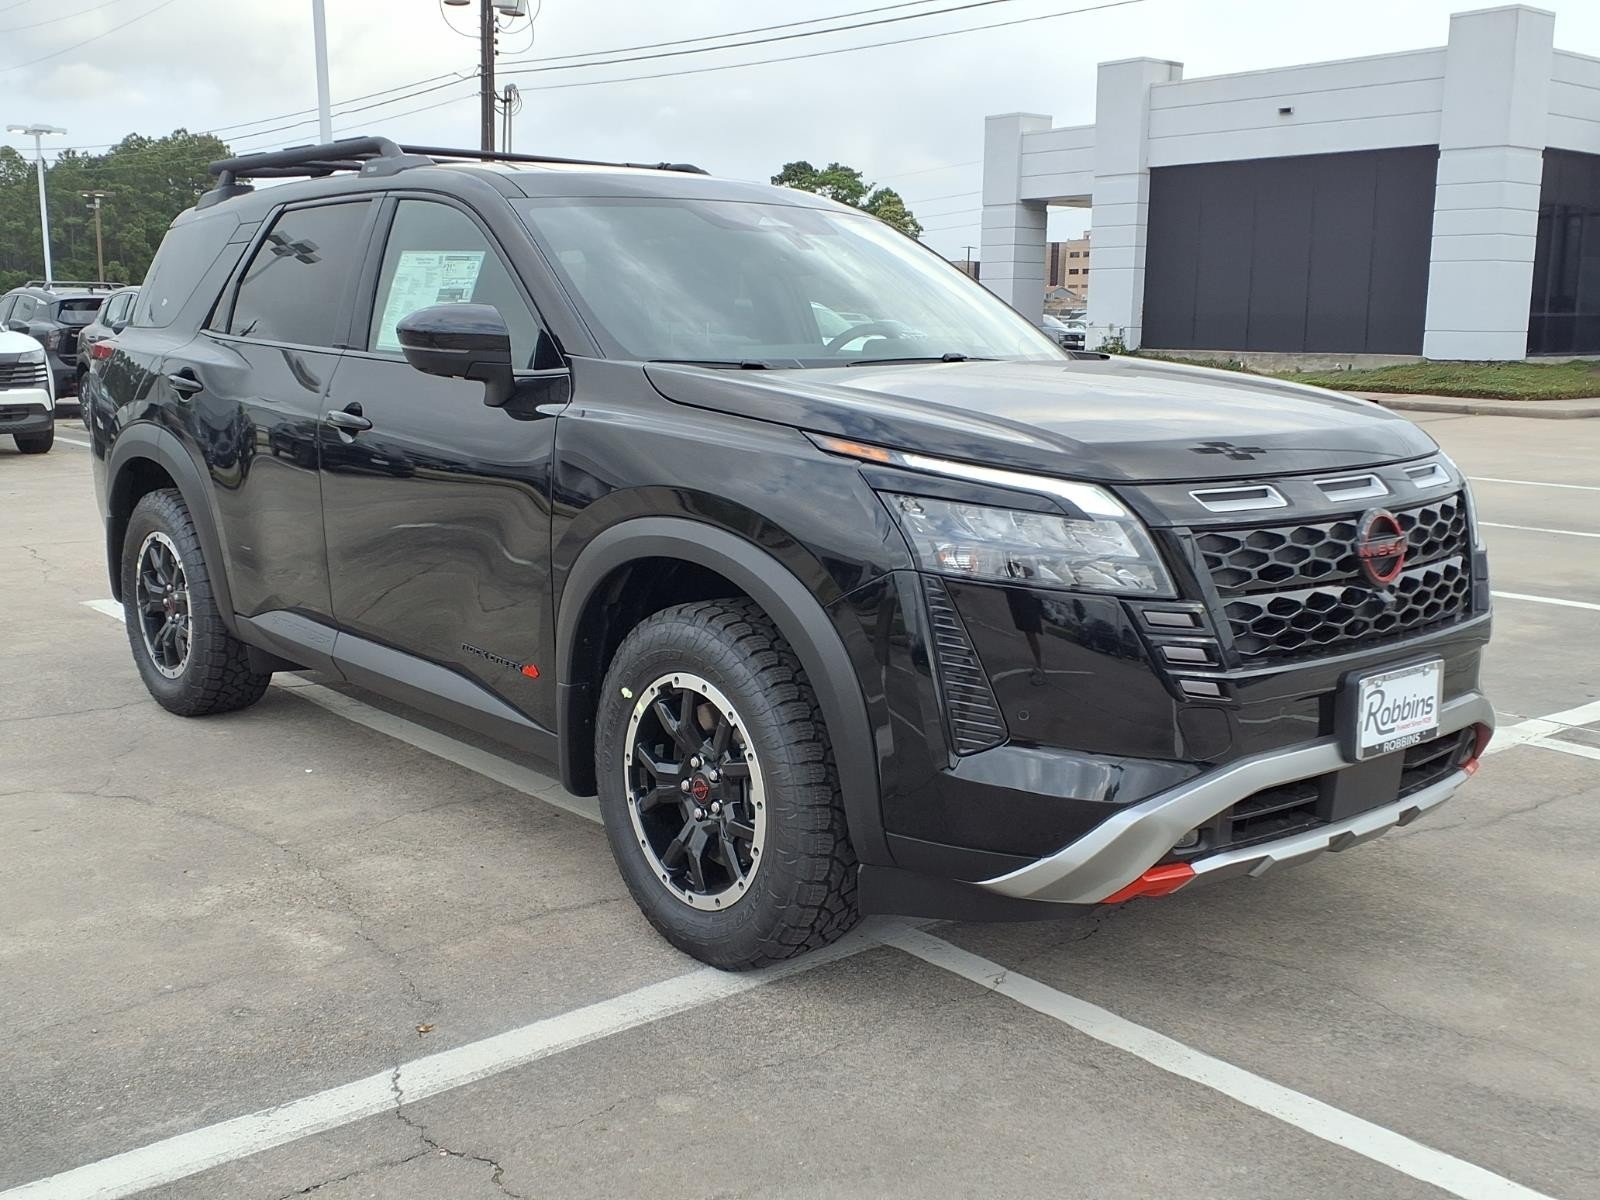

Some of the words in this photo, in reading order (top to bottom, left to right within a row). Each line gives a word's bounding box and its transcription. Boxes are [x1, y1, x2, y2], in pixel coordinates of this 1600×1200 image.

[1359, 540, 1408, 558] NSSA
[1364, 689, 1434, 736] Robbins
[1383, 733, 1421, 753] ROBBINS
